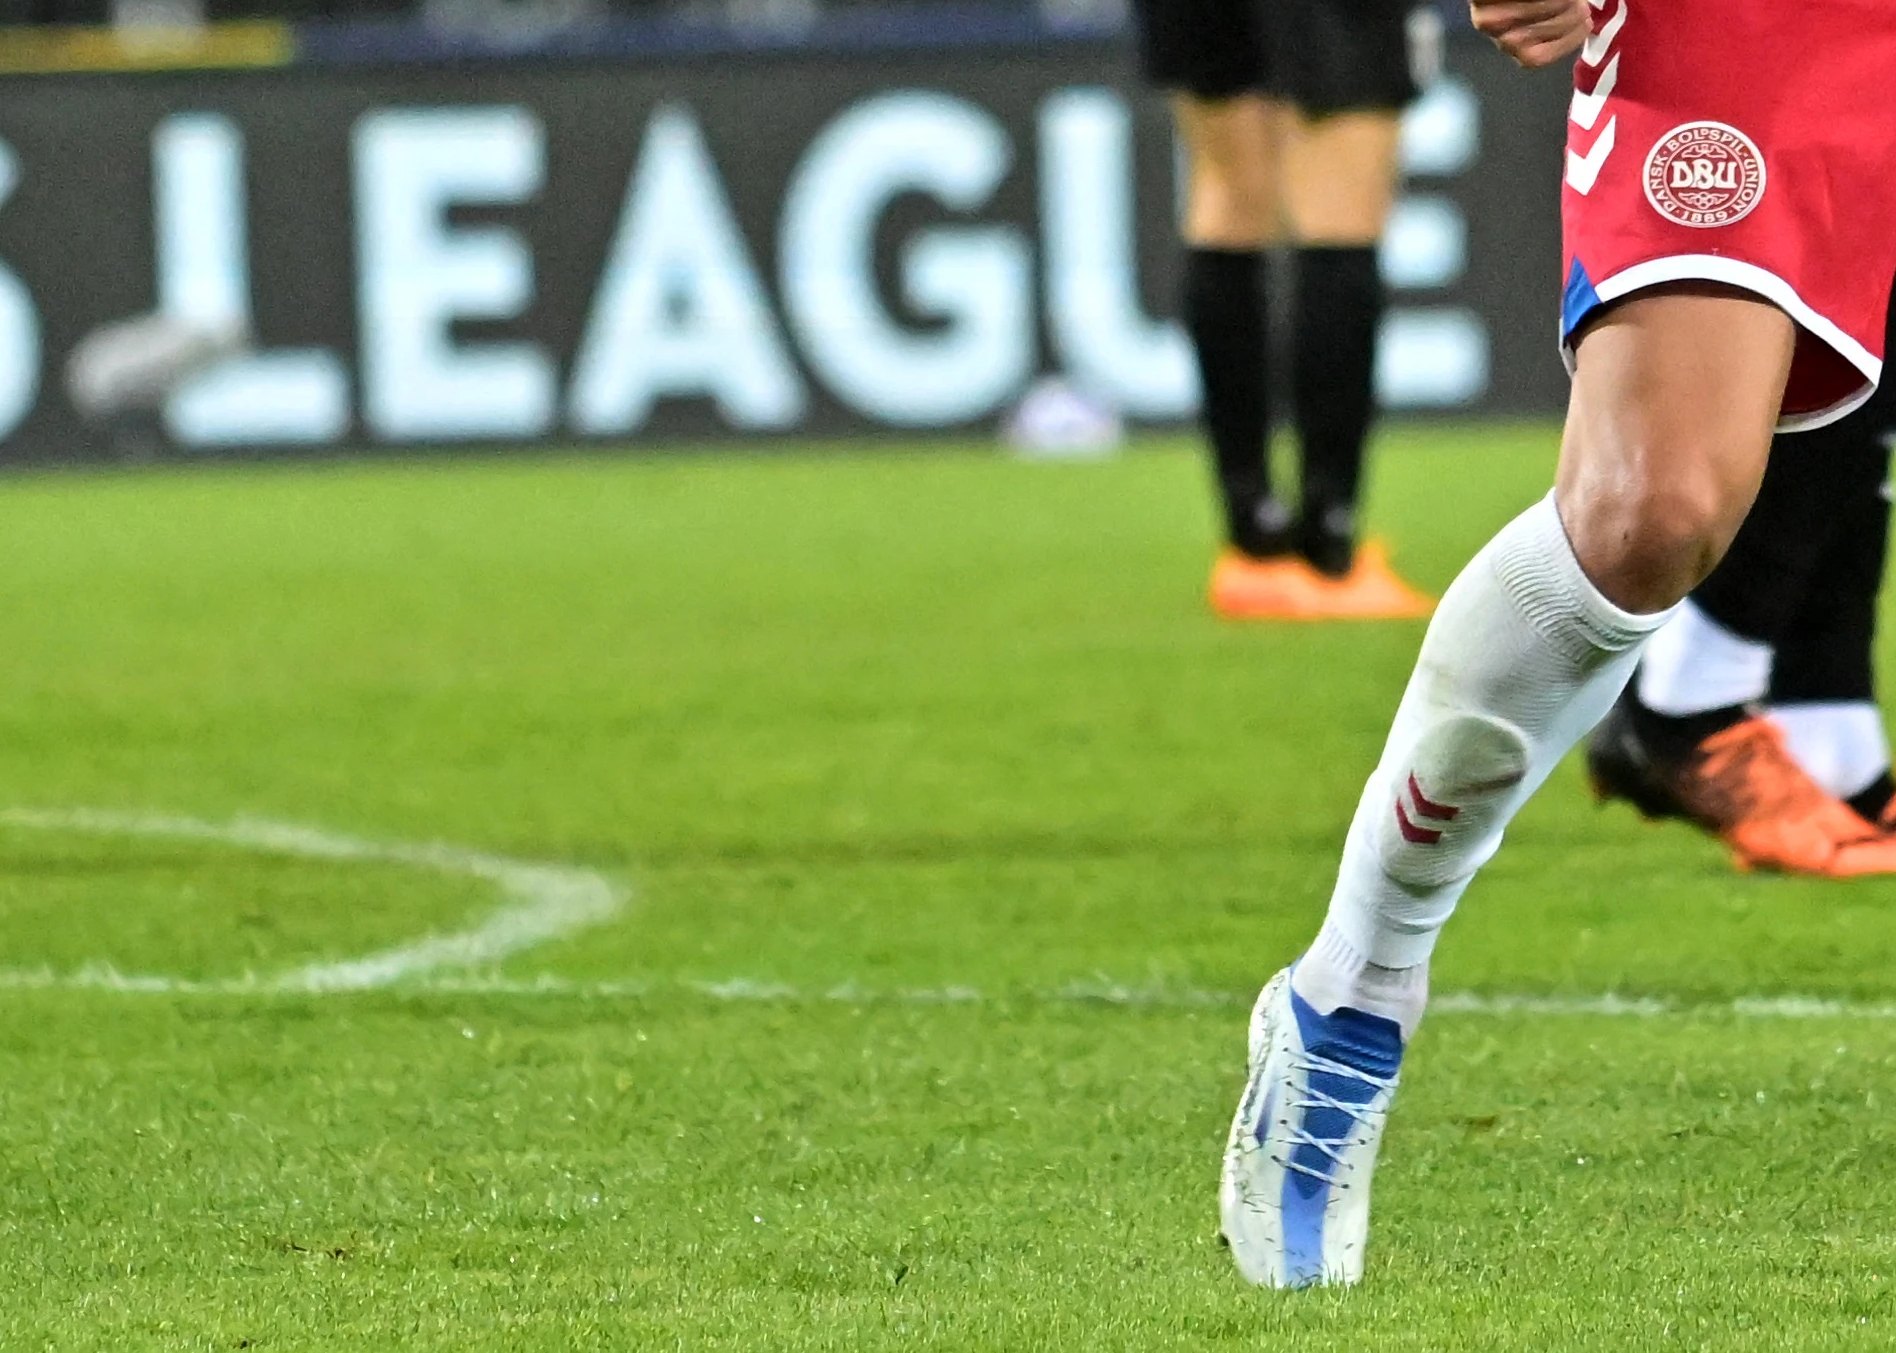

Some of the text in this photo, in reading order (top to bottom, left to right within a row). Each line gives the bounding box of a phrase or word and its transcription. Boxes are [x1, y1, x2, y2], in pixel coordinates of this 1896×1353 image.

[1650, 155, 1677, 212] DANSK
[1732, 159, 1760, 212] UNION
[1670, 159, 1738, 189] DBU
[1681, 211, 1728, 223] 1889
